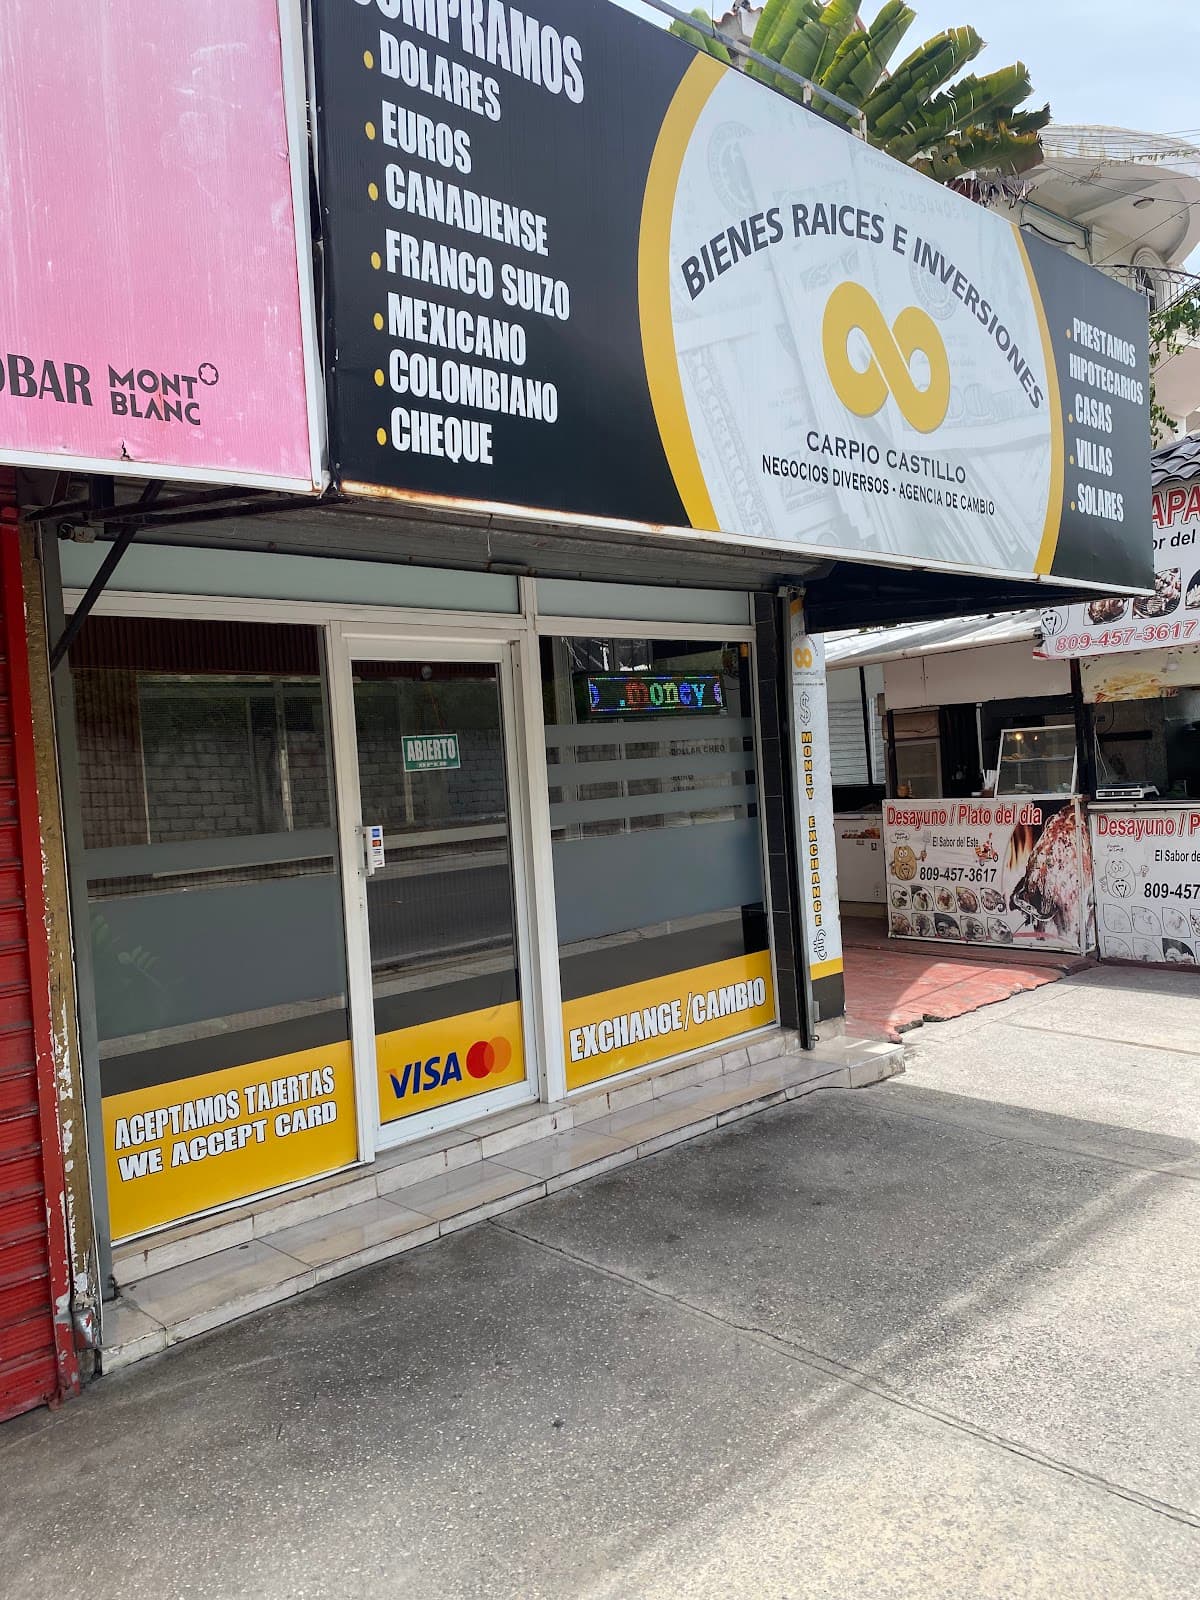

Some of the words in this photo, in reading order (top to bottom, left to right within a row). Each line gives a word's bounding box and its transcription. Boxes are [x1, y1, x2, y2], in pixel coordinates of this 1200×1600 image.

[354, 0, 584, 104] PRAMOS
[379, 29, 501, 121] DOLARES
[382, 99, 472, 174] EUROS
[385, 163, 549, 257] CANADIENSE
[385, 229, 494, 300] FRANCO
[501, 263, 570, 321] SUIZO
[387, 291, 527, 366] MEXICANO
[680, 206, 785, 301] BIENES
[791, 202, 885, 244] RAICES
[892, 223, 909, 256] E
[913, 236, 1044, 409] INVERSIONES
[1073, 317, 1136, 368] PRESTAMOS
[0, 353, 93, 406] BAR
[108, 364, 198, 399] MONT
[389, 349, 558, 424] COLOMBIANO
[1069, 353, 1143, 405] HIPOTECARIOS
[110, 391, 200, 426] BLANC
[1075, 393, 1113, 434] CASAS
[391, 406, 493, 465] CHEQUE
[806, 430, 880, 465] CARPIO
[886, 450, 966, 484] CASTILLO
[1076, 438, 1113, 477] VILLAS
[762, 454, 829, 484] NEGOCIOS
[832, 468, 890, 495] DIVERSOS
[899, 482, 943, 506] AGENCIA
[945, 491, 958, 509] DE
[960, 495, 995, 516] CAMBIO
[1077, 483, 1124, 522] SOLARES
[1171, 529, 1195, 546] del
[1055, 619, 1199, 653] 809-457-3617
[407, 738, 456, 761] ABIERTO
[801, 731, 814, 800] MONEY
[808, 816, 822, 927] EXCHANGE
[886, 805, 947, 830] Desayuno
[957, 803, 992, 826] Plato
[995, 803, 1017, 825] del
[932, 836, 938, 847] El
[939, 836, 956, 847] Sabor
[1097, 812, 1176, 842] Desayuno
[920, 867, 997, 883] 809-457-3617
[1154, 849, 1163, 862] El
[1164, 849, 1189, 862] Sabor
[386, 1052, 462, 1099] VISA
[114, 1089, 240, 1150] ACEPTAMOS
[244, 1066, 335, 1115] TAJERTAS
[118, 1147, 164, 1182] WE
[171, 1119, 268, 1168] ACCEPT
[274, 1101, 337, 1137] CARD
